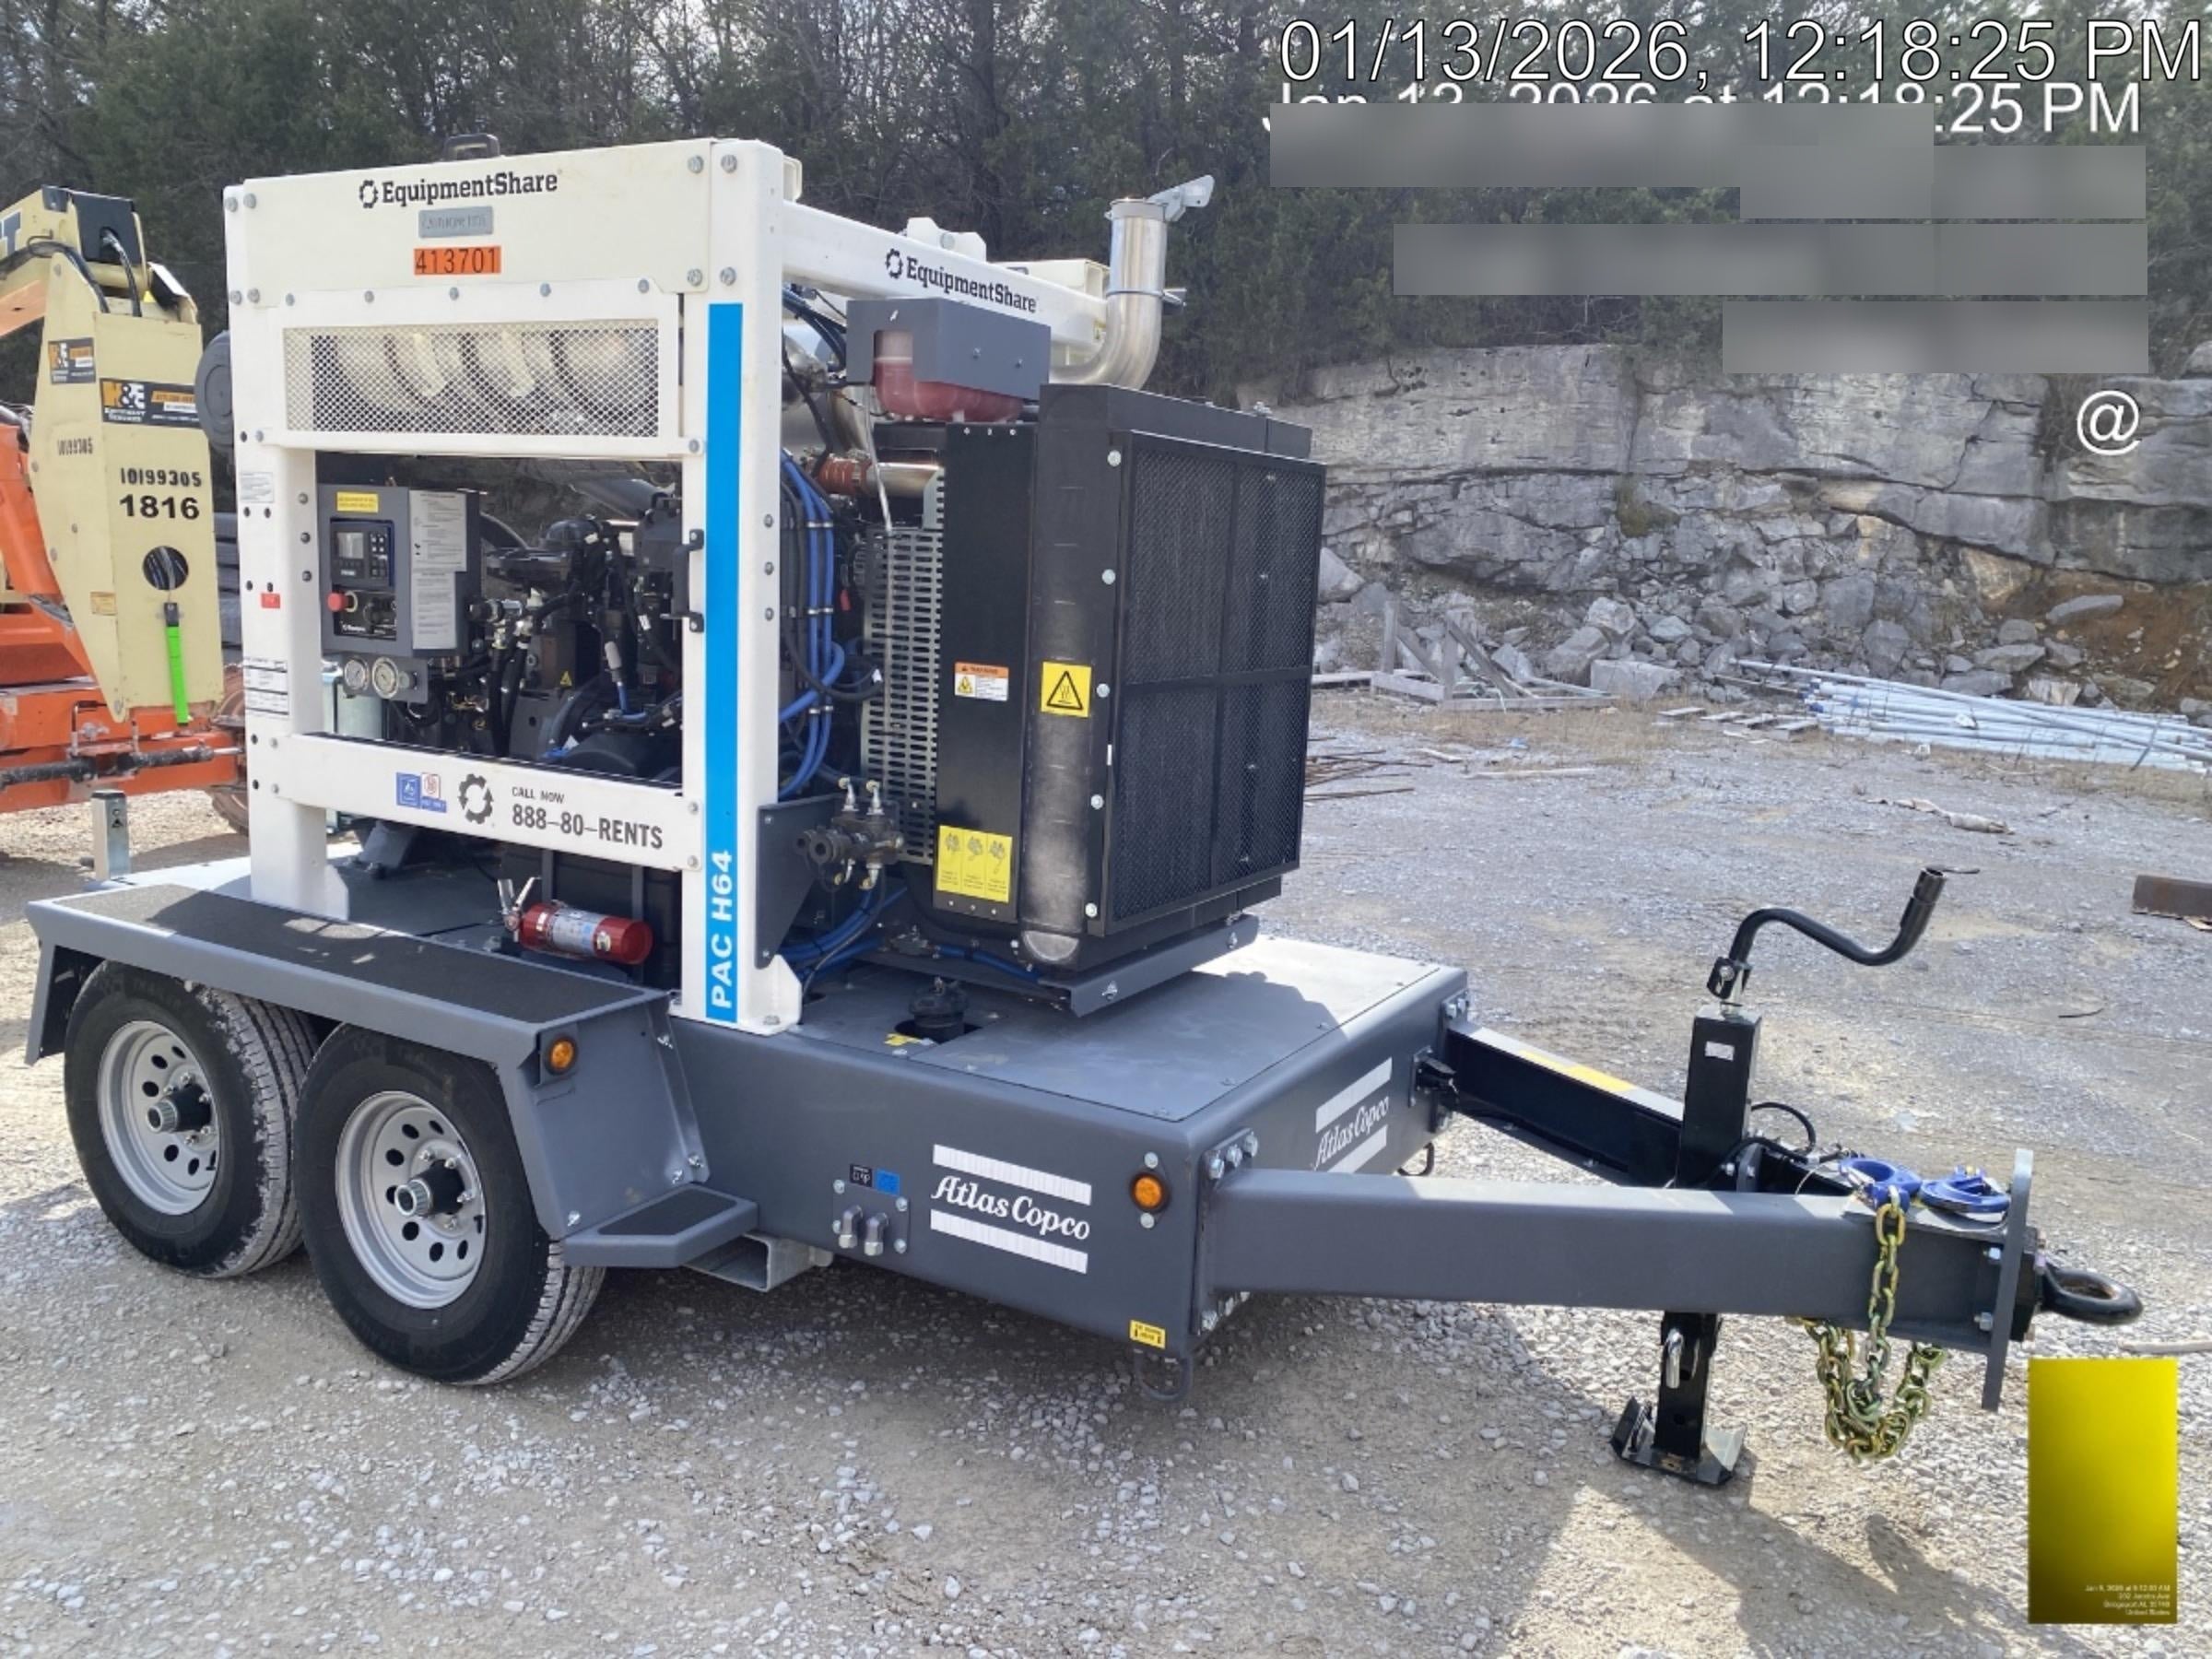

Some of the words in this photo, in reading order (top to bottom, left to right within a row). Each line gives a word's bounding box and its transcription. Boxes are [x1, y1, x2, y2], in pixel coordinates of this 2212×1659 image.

[382, 171, 559, 207] EquipmentShare
[415, 246, 497, 275] 413701
[906, 255, 1038, 314] EquipmentShare
[120, 467, 202, 488] 10199305
[119, 493, 200, 520] 1816
[512, 786, 536, 801] CALL
[540, 790, 565, 804] NOW
[512, 803, 664, 849] 888-80-RENTS
[711, 850, 734, 923] H64
[711, 933, 734, 1009] PAC
[1311, 1122, 1355, 1171] Atlas
[1353, 1096, 1390, 1137] Copco
[930, 1175, 1010, 1218] Atlas
[1012, 1194, 1090, 1241] Copco
